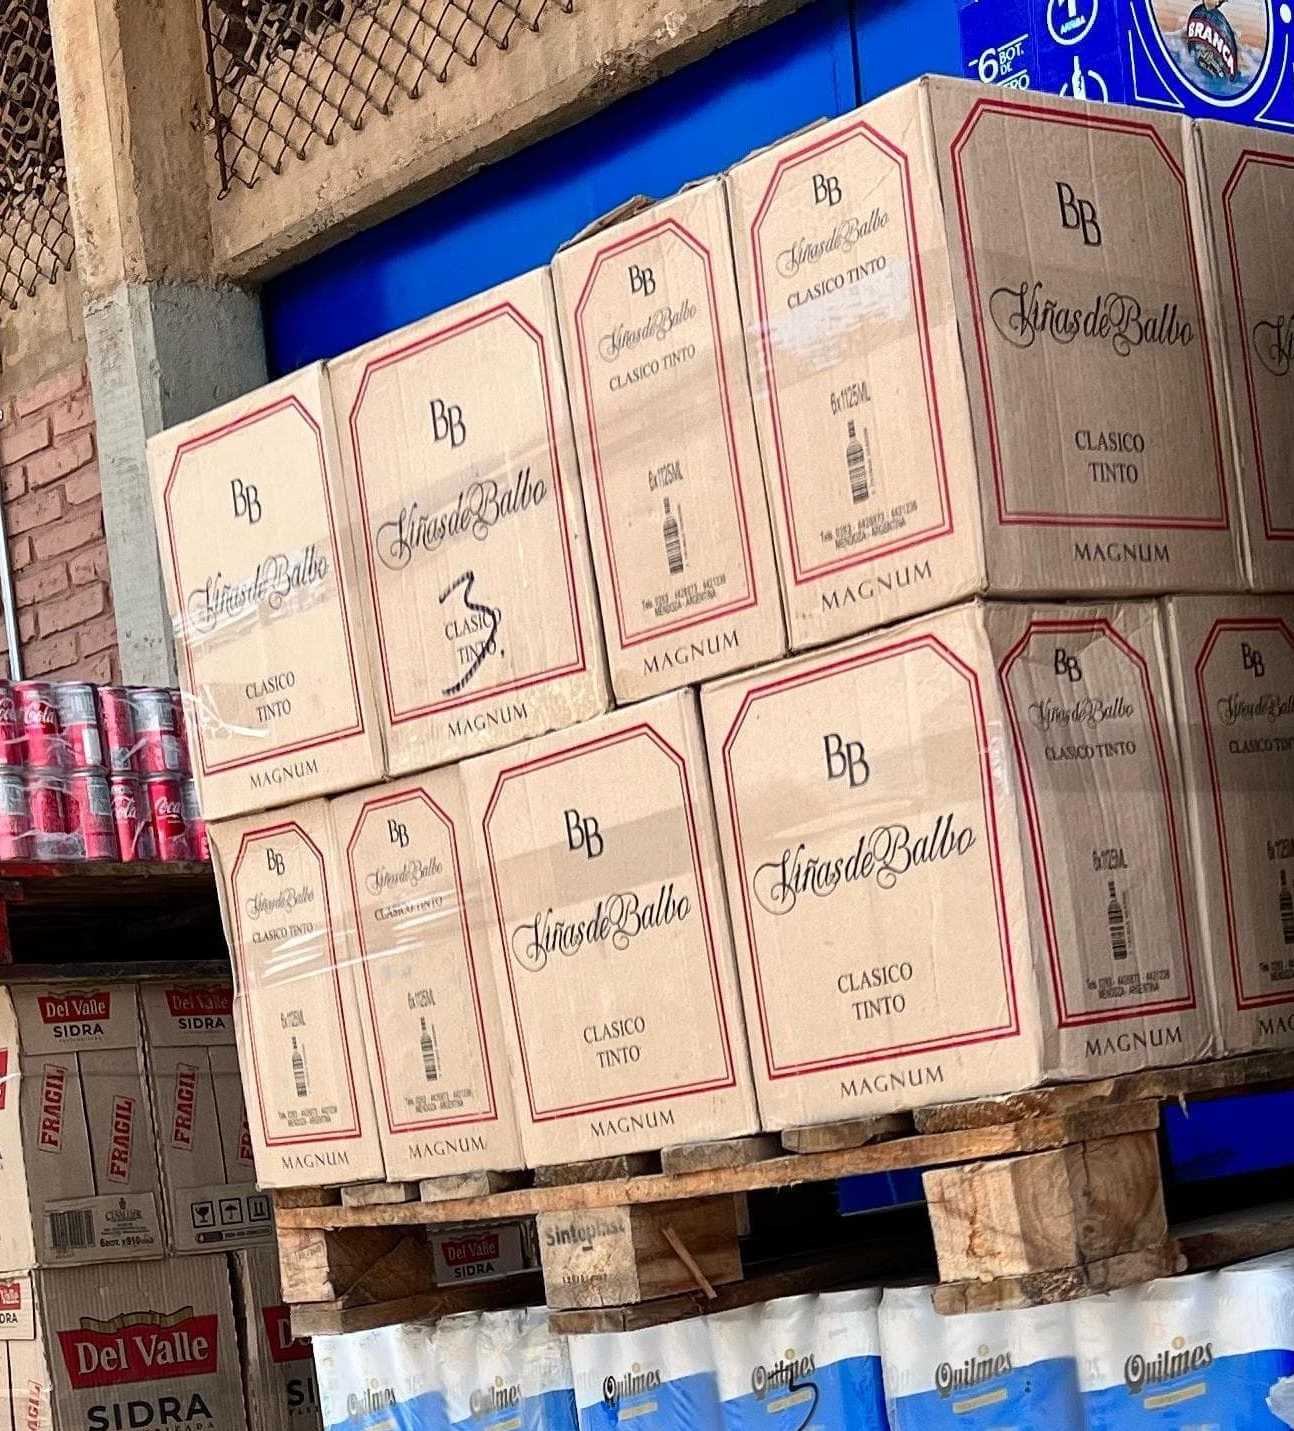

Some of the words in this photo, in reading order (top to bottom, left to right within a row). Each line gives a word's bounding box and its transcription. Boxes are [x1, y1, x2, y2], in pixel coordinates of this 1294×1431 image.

[999, 42, 1024, 64] BOT.
[1187, 20, 1236, 76] BRANCA
[978, 48, 998, 84] 6
[1000, 61, 1013, 75] DE
[1056, 181, 1102, 246] BB
[787, 270, 845, 310] CLASICO
[847, 255, 887, 285] TINTO
[429, 399, 467, 448] BB
[1075, 430, 1144, 455] CLASICO
[1089, 462, 1138, 484] TINTO
[1074, 542, 1170, 564] MAGNUM
[820, 560, 933, 614] MAGNUM
[643, 629, 741, 677] MAGNUM
[447, 703, 529, 740] MAGNUM
[823, 733, 869, 789] BB
[1044, 742, 1094, 762] CLASICO
[1097, 739, 1135, 757] TINTO
[837, 962, 913, 994] CLASICO
[45, 1001, 70, 1017] Del
[73, 999, 106, 1016] Valle
[852, 994, 906, 1021] TINTO
[54, 1023, 104, 1038] SIDRA
[584, 1016, 645, 1043] CLASICO
[1085, 1026, 1183, 1057] MAGNUM
[597, 1046, 641, 1068] TINTO
[840, 1064, 944, 1099] MAGNUM
[110, 1099, 133, 1179] FRAGIL
[590, 1110, 675, 1138] MAGNUM
[454, 1261, 495, 1279] SIDRA
[75, 1339, 129, 1375] Del
[133, 1331, 209, 1367] Valle
[1124, 1340, 1213, 1394] Quilmes
[603, 1362, 660, 1409] Quilmes
[935, 1345, 1012, 1397] Quilmes
